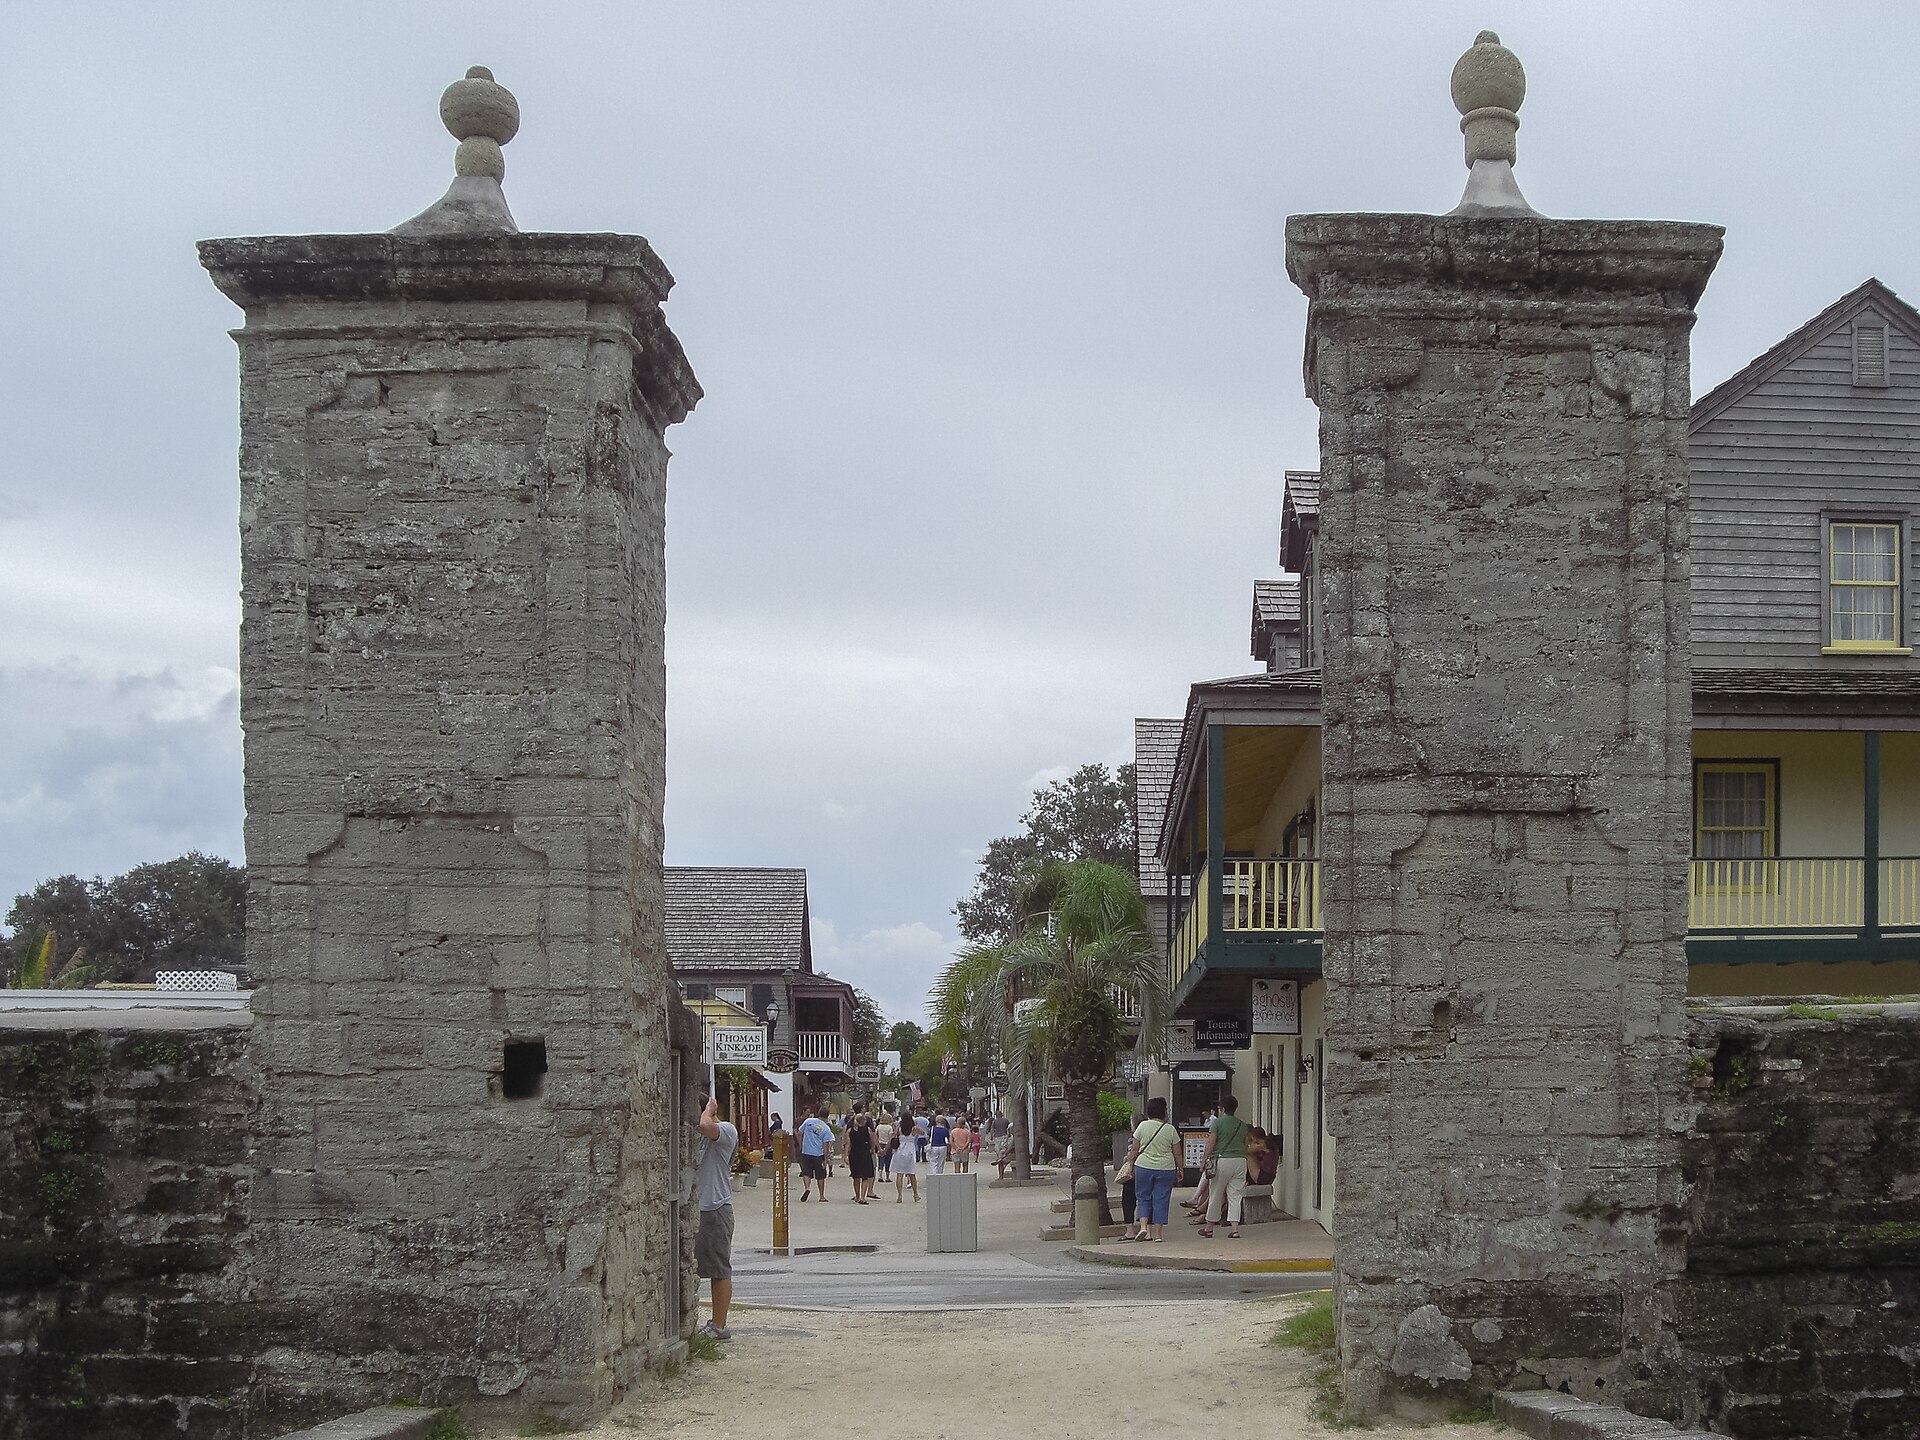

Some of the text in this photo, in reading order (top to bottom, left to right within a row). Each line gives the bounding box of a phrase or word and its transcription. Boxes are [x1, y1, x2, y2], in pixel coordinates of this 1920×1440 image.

[1253, 1010, 1295, 1022] experience
[1207, 1020, 1239, 1029] Tourist
[716, 1033, 760, 1043] THOMAS
[1196, 1030, 1248, 1040] Information
[716, 1043, 762, 1052] KINKADE
